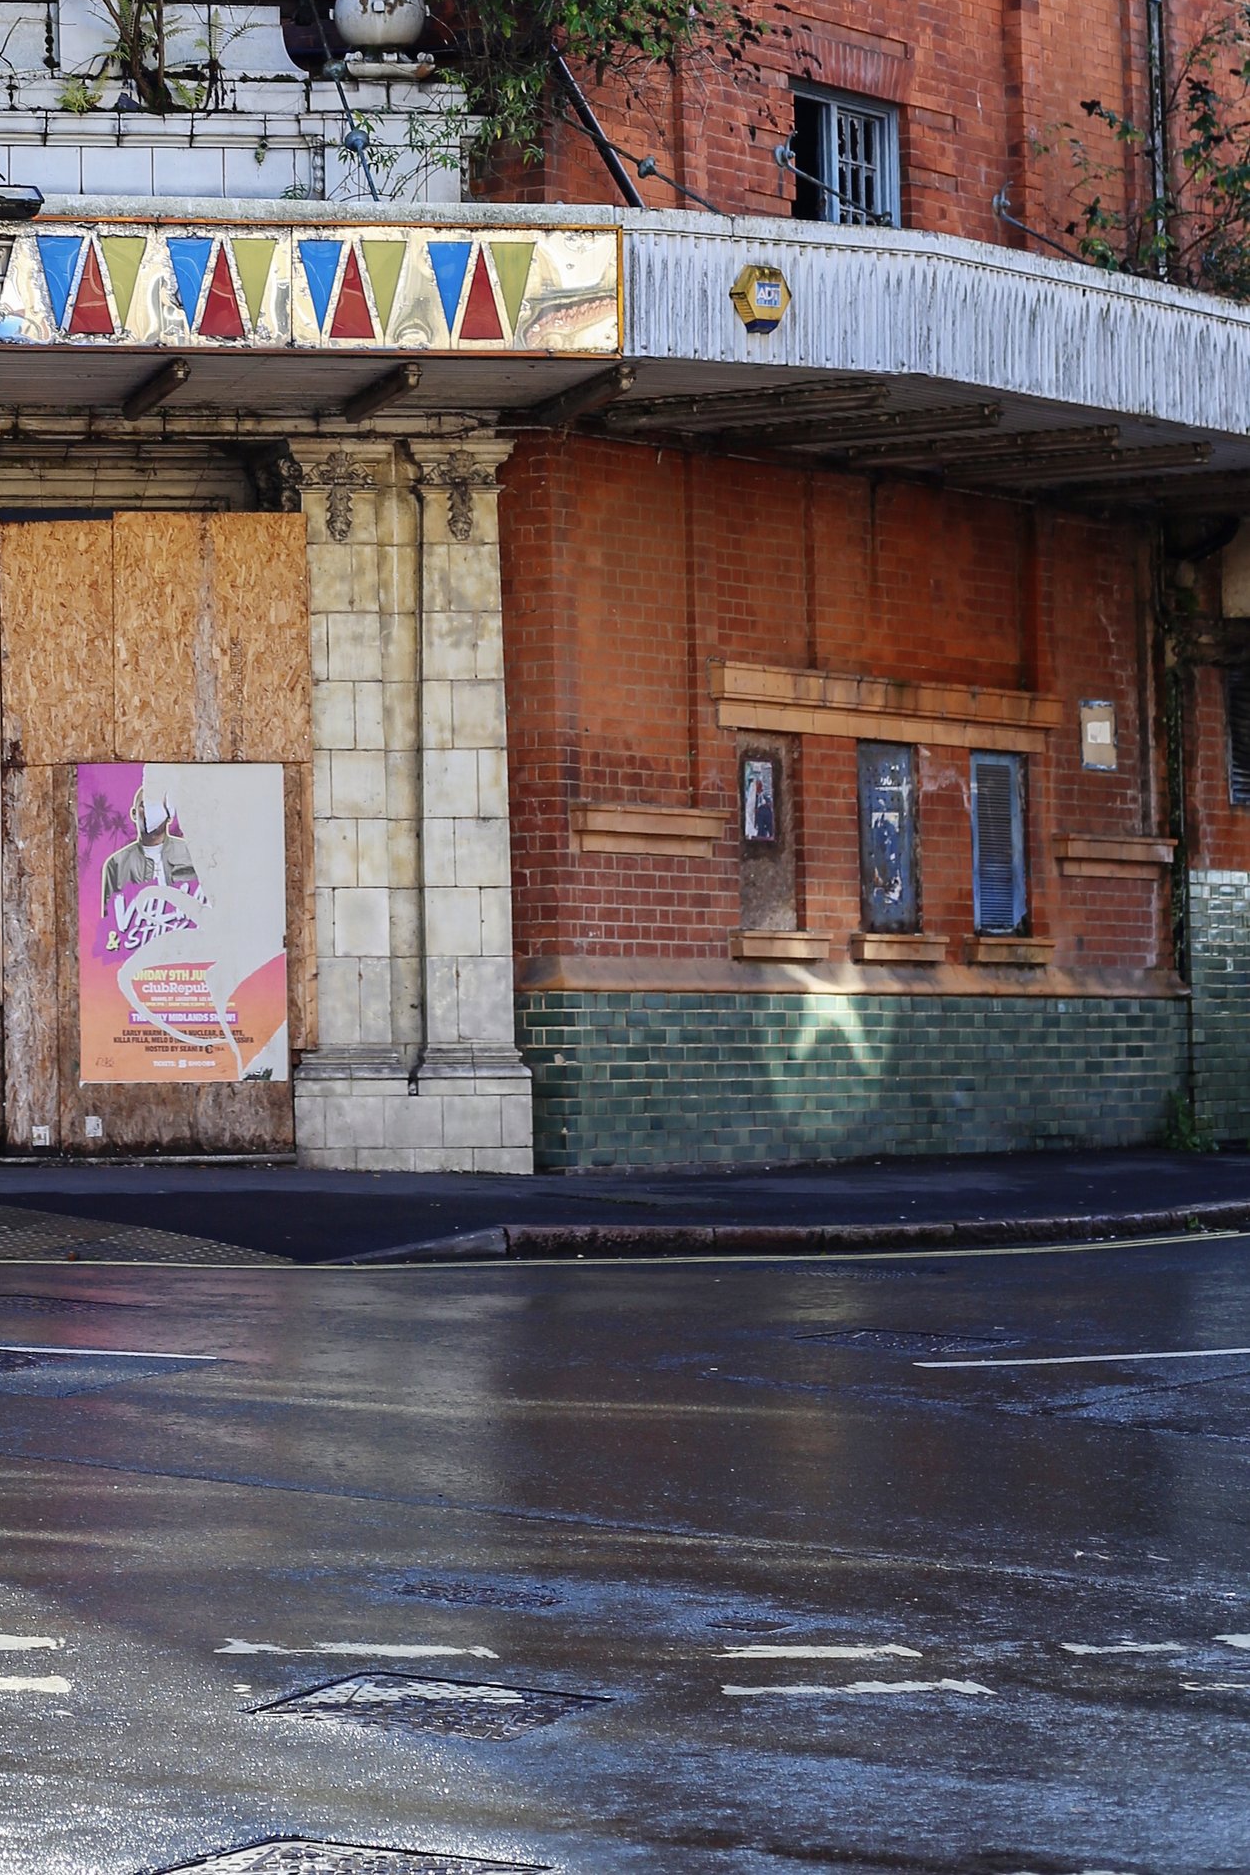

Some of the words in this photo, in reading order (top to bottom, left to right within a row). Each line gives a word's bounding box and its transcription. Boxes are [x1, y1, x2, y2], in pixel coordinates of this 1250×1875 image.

[757, 286, 780, 301] ADT
[105, 931, 120, 951] &
[169, 970, 189, 981] 9TH
[142, 982, 210, 995] clubRepub
[169, 1013, 209, 1022] MIDLANDS
